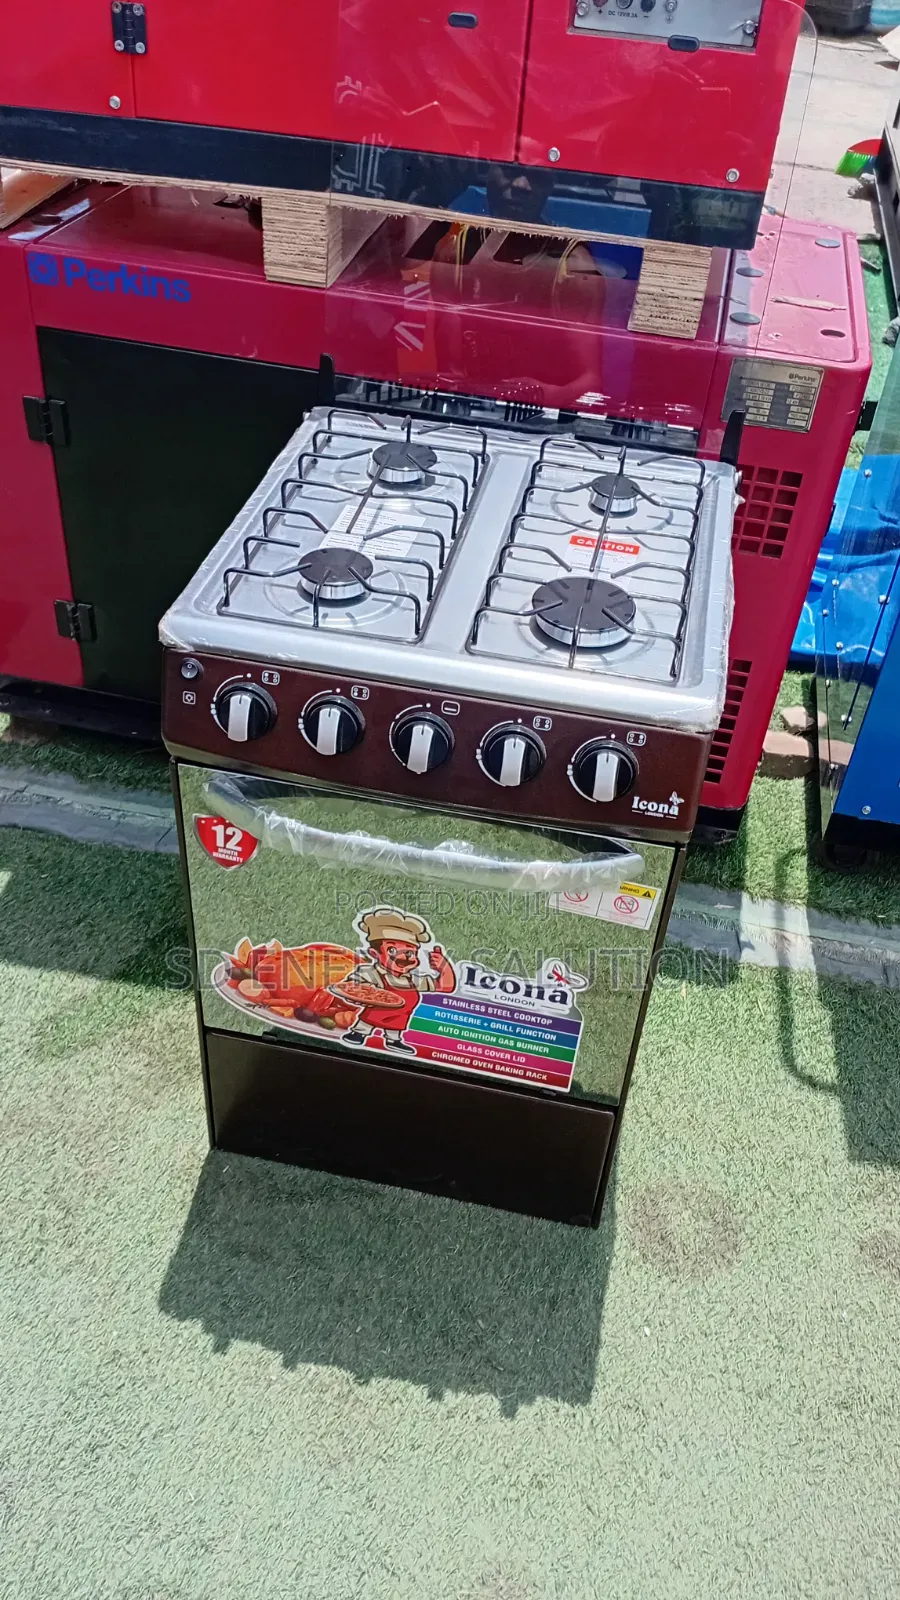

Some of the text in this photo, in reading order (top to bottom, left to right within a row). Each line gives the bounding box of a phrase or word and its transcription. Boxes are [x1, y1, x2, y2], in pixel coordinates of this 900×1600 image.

[63, 257, 192, 303] Perkins
[576, 538, 634, 552] CATION
[631, 796, 679, 816] Icona
[211, 824, 243, 852] 12
[464, 966, 569, 1006] Icona
[494, 994, 536, 1007] LONDON
[434, 1010, 482, 1026] ROTISSERIE
[490, 1022, 514, 1033] GRILL
[515, 1027, 557, 1042] FUNCTION
[442, 997, 553, 1026] STAINLESS STEEL COOKTOP
[438, 1025, 549, 1054] AUTO IGNITION GAS BURNER
[457, 1043, 526, 1064] GLASS COVER LID
[431, 1051, 548, 1081] CHROMED OVEN BAKING RACK
